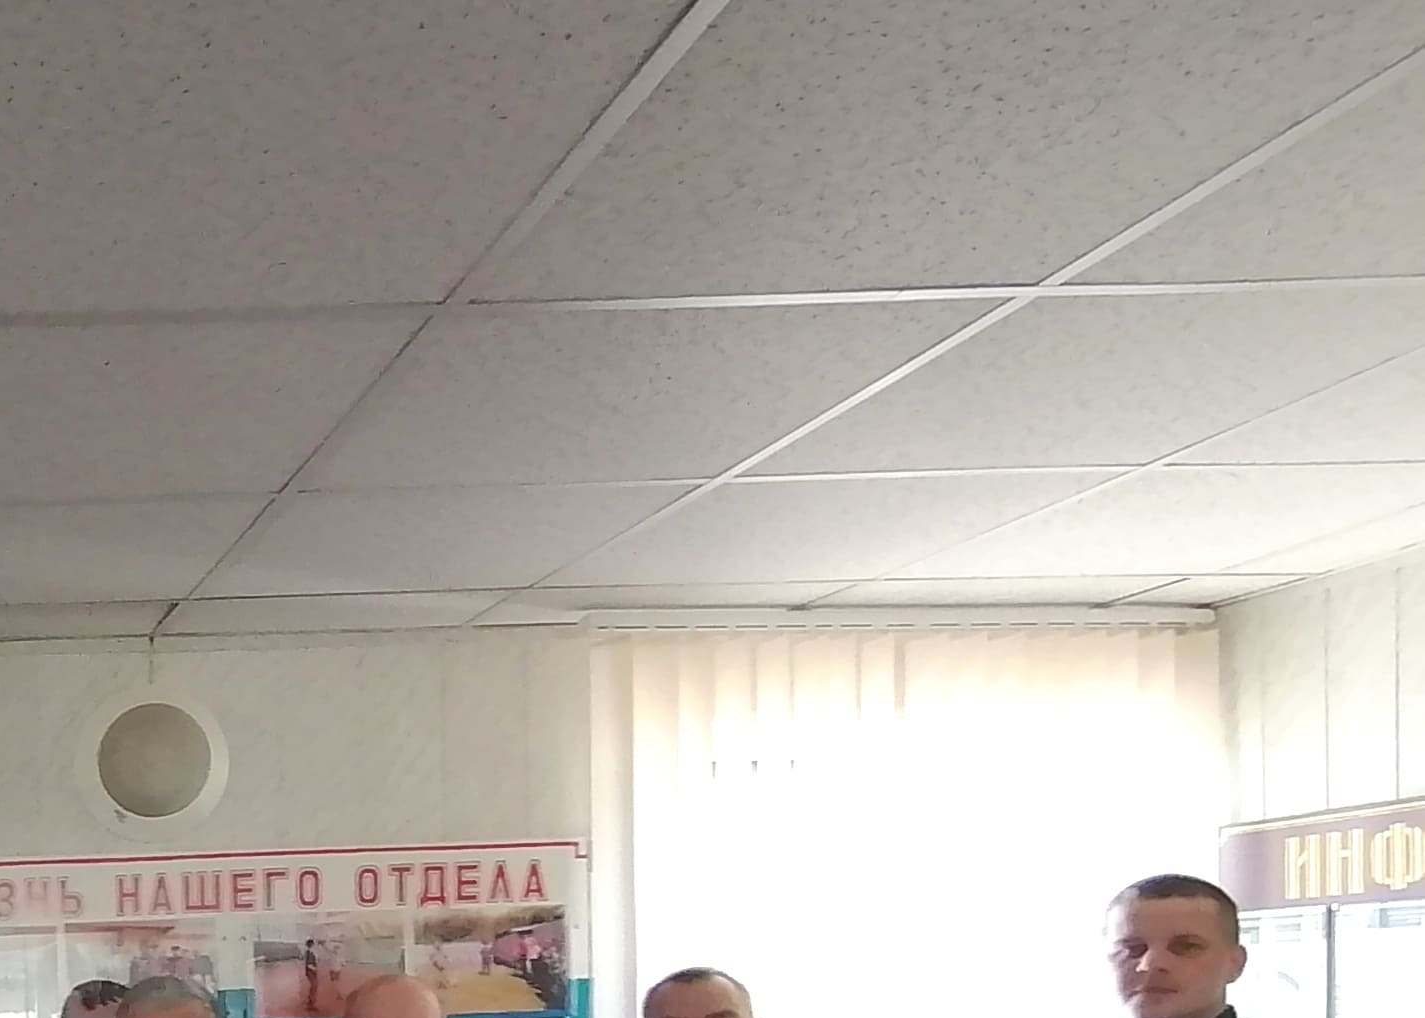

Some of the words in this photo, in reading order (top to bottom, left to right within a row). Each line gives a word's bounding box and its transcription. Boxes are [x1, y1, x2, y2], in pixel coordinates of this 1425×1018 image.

[115, 866, 321, 917] НАШЕГО
[355, 859, 549, 908] ОТДЕЛА
[1284, 822, 1425, 900] ИНФ
